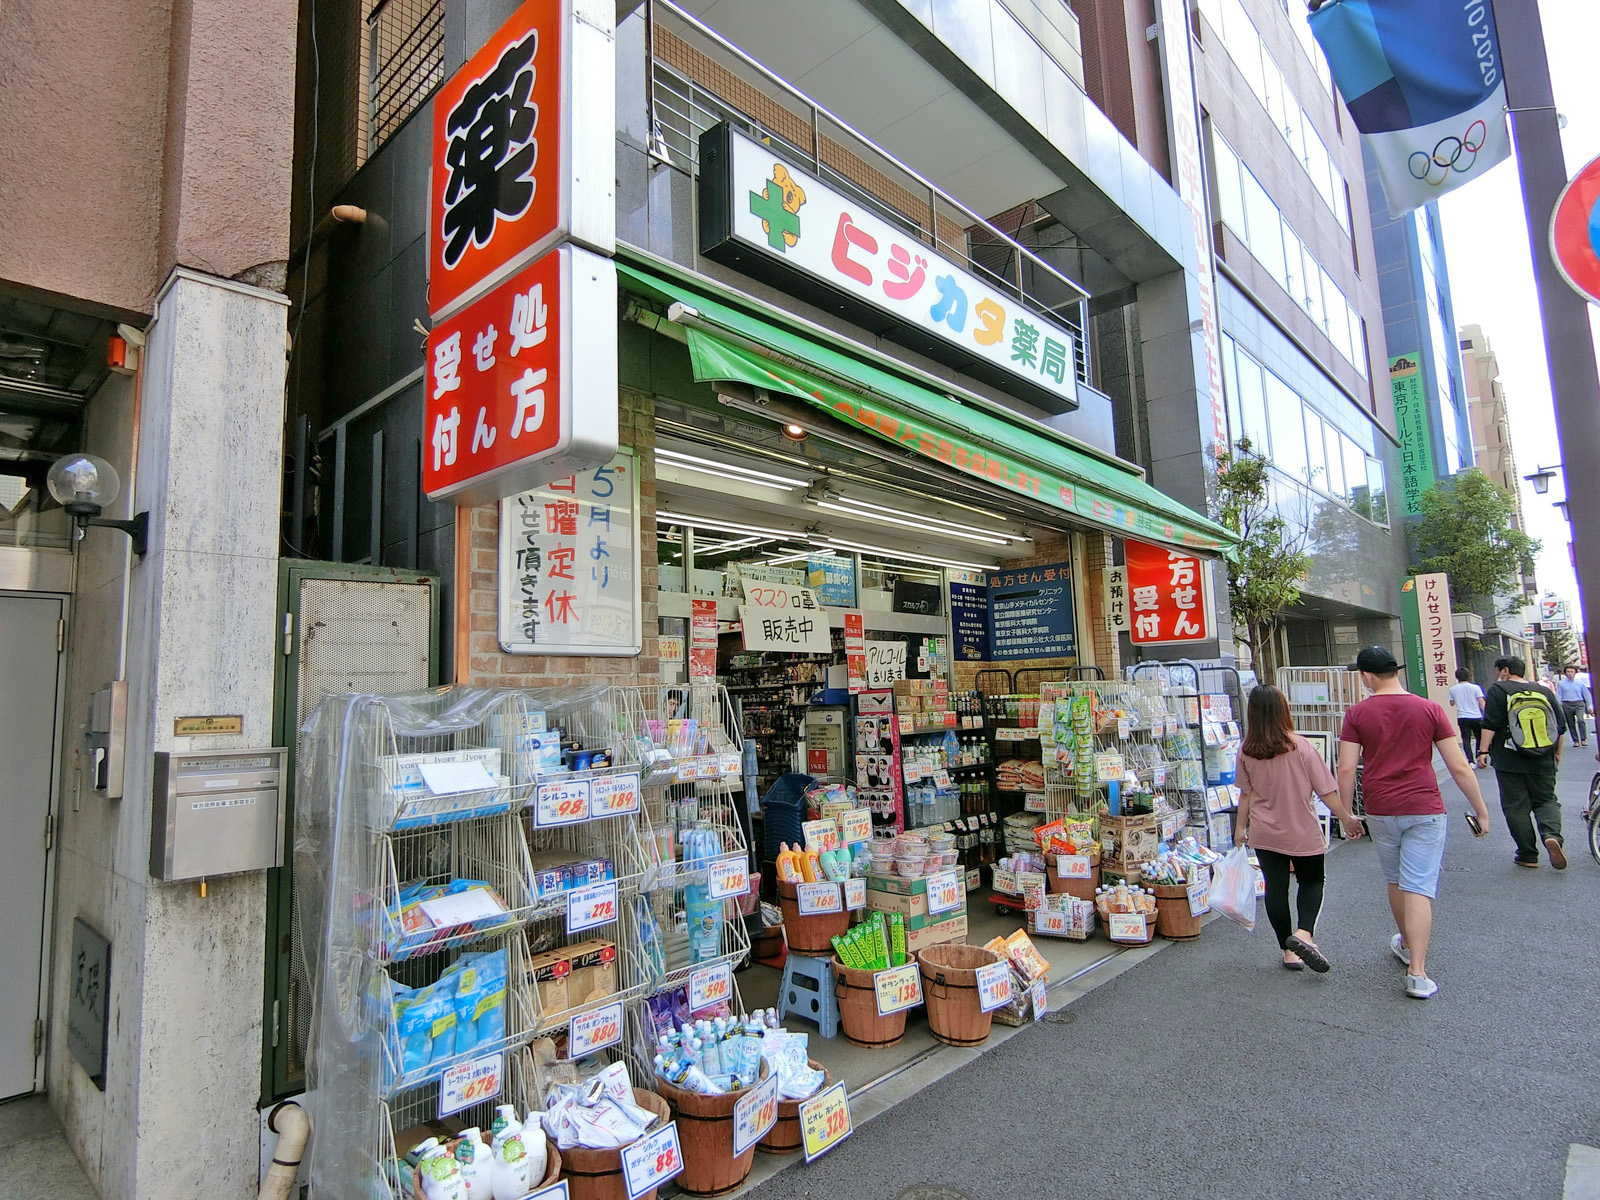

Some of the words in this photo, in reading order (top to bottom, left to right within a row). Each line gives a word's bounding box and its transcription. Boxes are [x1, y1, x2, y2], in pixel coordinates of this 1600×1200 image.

[1472, 24, 1496, 87] 2020
[441, 28, 538, 270] 薬
[831, 212, 1066, 384] ヒジカタ薬局
[1393, 381, 1421, 514] 東京ワールド日本語学校
[989, 567, 1070, 588] 処方せん受付
[762, 615, 814, 643] 販売中
[1133, 585, 1161, 639] 受付
[1424, 579, 1448, 686] けんせつプラザ東京
[434, 756, 456, 764] IVORY
[465, 753, 487, 761] IVORY
[542, 790, 585, 801] シルコット
